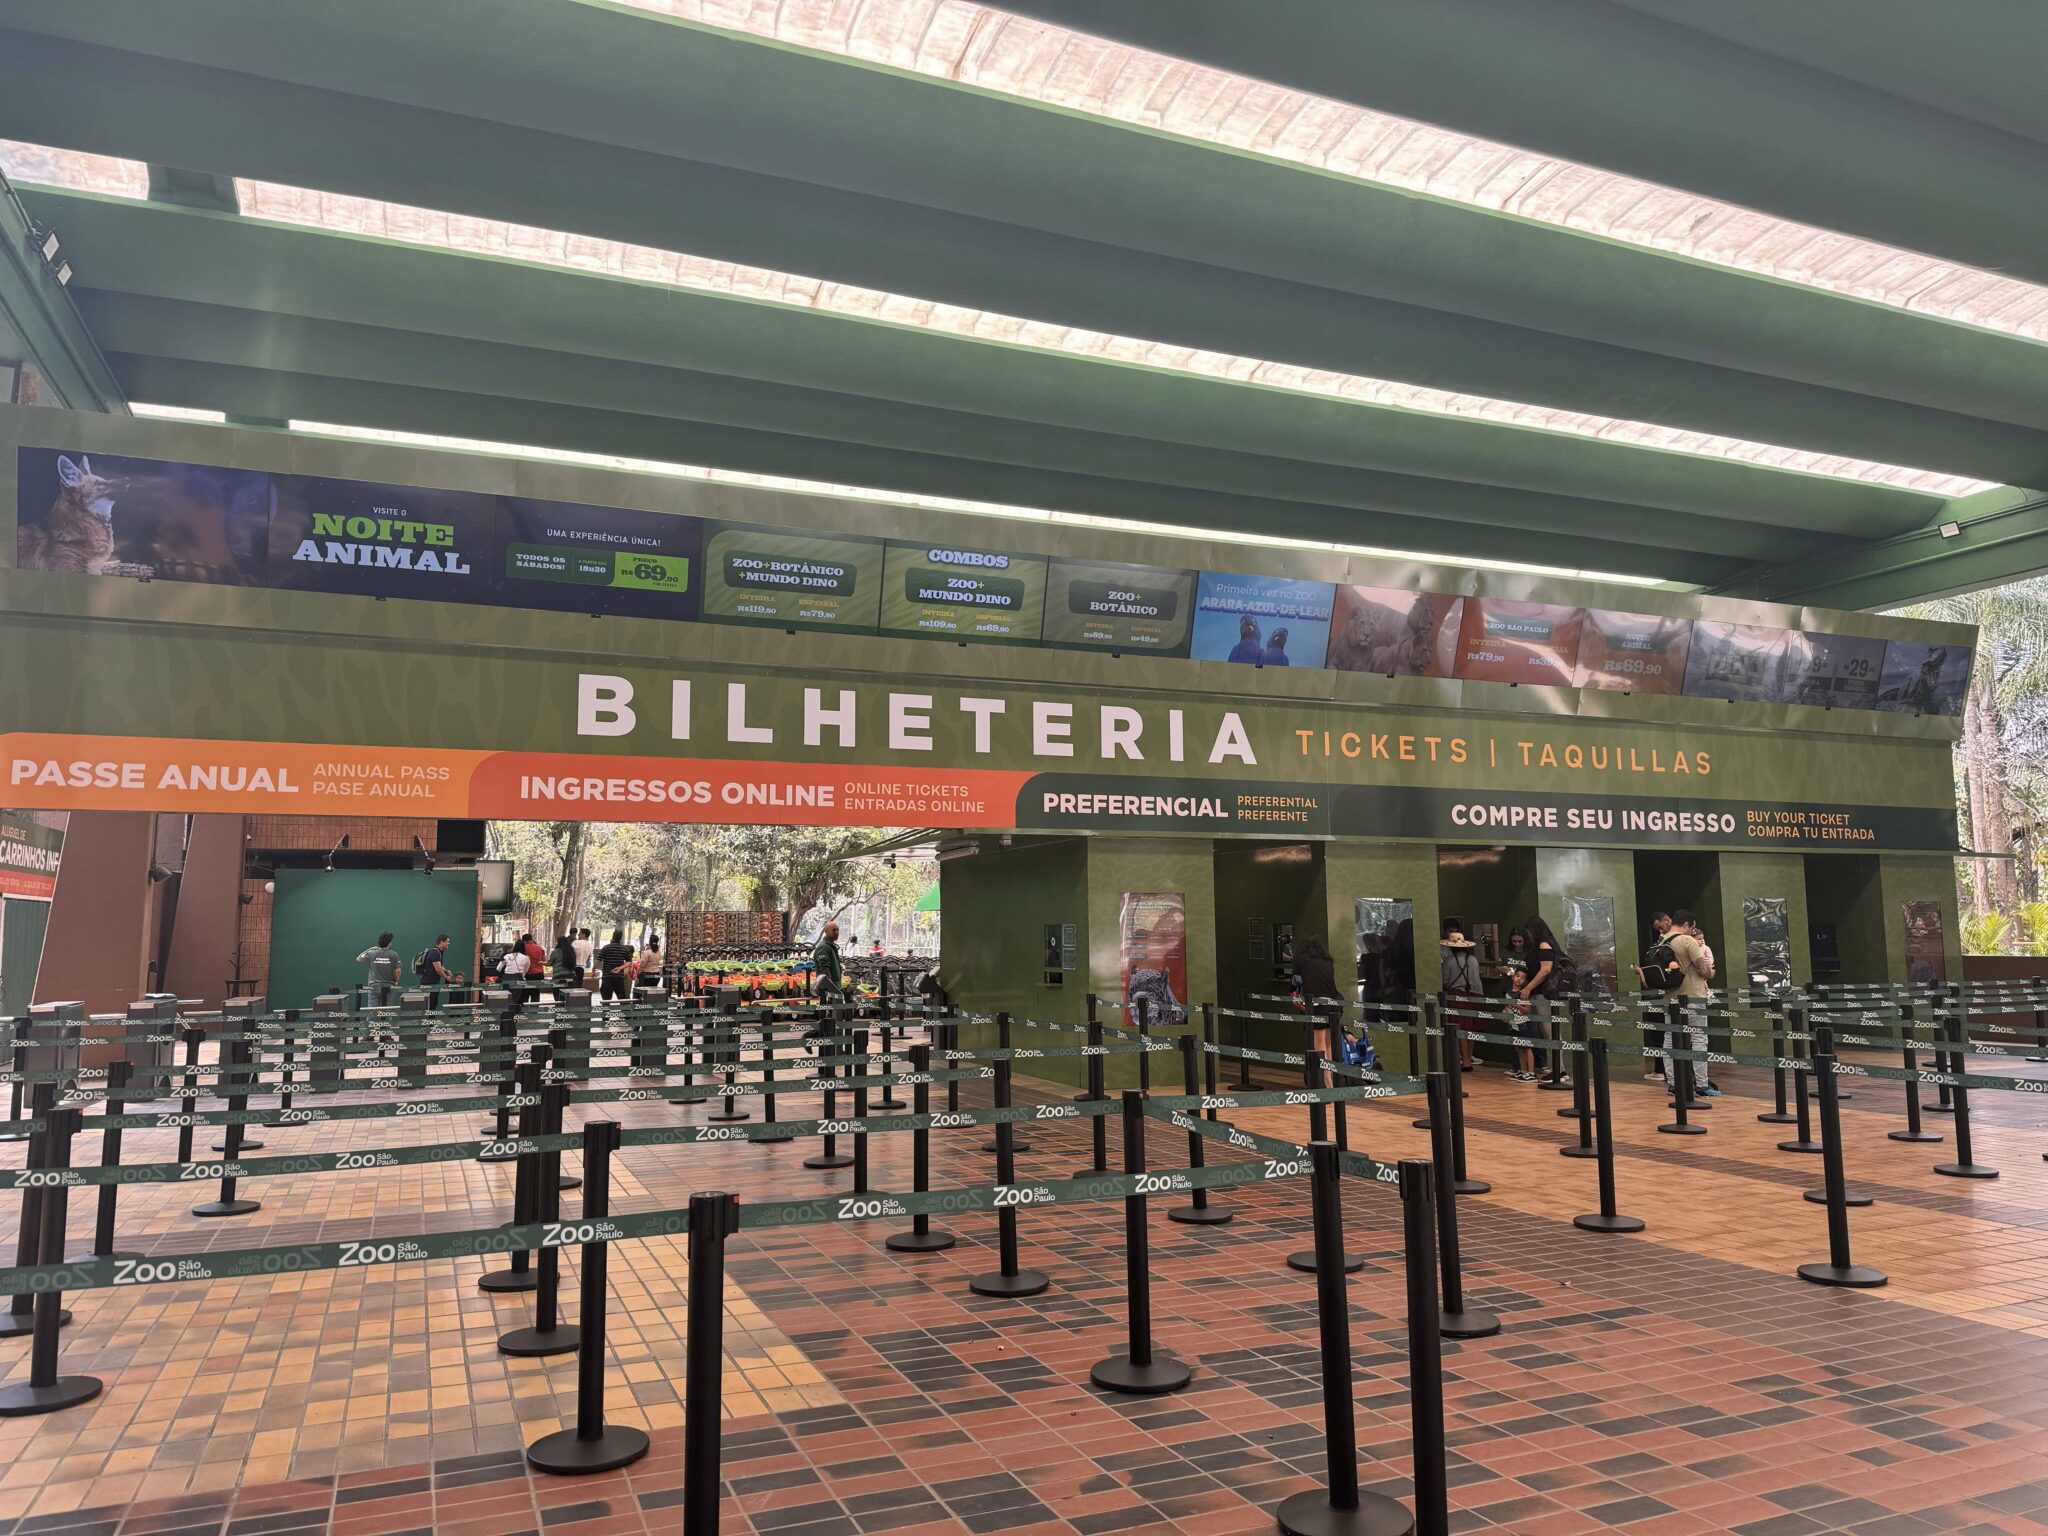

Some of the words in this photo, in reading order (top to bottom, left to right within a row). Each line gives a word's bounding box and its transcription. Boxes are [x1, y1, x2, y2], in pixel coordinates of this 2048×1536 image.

[373, 506, 398, 516] VISITE
[313, 513, 454, 546] NOITE
[547, 529, 567, 538] UMA
[570, 531, 629, 544] EXPERIÊNCIA
[631, 535, 661, 547] ÚNICA!
[293, 540, 470, 575] ANIMAL
[516, 554, 550, 562] TODOS
[928, 549, 1009, 568] COMBOS
[516, 560, 565, 571] SÁBADOS!
[802, 577, 838, 588] DINO
[919, 588, 974, 602] MUNDO
[975, 593, 1011, 605] DINO
[1217, 583, 1259, 597] Primeira
[1261, 589, 1278, 598] vez
[1280, 591, 1292, 599] no
[1090, 601, 1158, 616] BOTÂNICO
[1201, 597, 1329, 619] ARARA-AZUL-DE-LEAR
[1507, 623, 1522, 631] SÃO
[1523, 626, 1549, 634] PAULO
[1621, 641, 1652, 650] ANIMAL
[577, 673, 1258, 765] BILHETERIA
[1295, 730, 1467, 763] TICKETS
[1518, 742, 1711, 775] TAQUILLAS
[10, 760, 146, 789] PASSE
[157, 764, 299, 793] ANUAL
[313, 762, 394, 779] ANNUAL
[401, 765, 450, 780] PASS
[313, 781, 363, 796] PASE
[369, 783, 435, 798] ANUAL
[520, 775, 712, 805] INGRESSOS
[722, 782, 835, 808] ONLINE
[844, 782, 901, 796] ONLINE
[905, 783, 968, 798] TICKETS
[844, 798, 926, 813] ENTRADAS
[930, 799, 985, 814] ONLINE
[1043, 793, 1228, 818] PREFERENCIAL
[1237, 795, 1318, 809] PREFERENTIAL
[1238, 809, 1308, 822] PREFERENTE
[1451, 804, 1558, 828] COMPRE
[1567, 808, 1613, 830] SEU
[1622, 810, 1736, 833] INGRESSO
[1747, 810, 1770, 823] BUY
[1773, 811, 1805, 824] YOUR
[1809, 813, 1850, 826] TICKET
[1, 825, 19, 839] ALUGUEL
[20, 829, 27, 841] DE
[1748, 825, 1799, 838] COMPRA
[1803, 827, 1818, 839] TU
[1822, 828, 1875, 840] ENTRADA
[0, 840, 46, 870] CARRINHOS
[1733, 1029, 1748, 1037] Zoo
[1989, 1024, 2005, 1033] Zoo
[1906, 1039, 1924, 1049] Zoo
[1707, 1052, 1726, 1063] Zoo
[1778, 1058, 1799, 1069] Zoo
[78, 1068, 103, 1077] Zoo
[712, 1063, 735, 1073] Zoo
[1832, 1062, 1855, 1074] Zoo
[466, 1072, 491, 1083] Zoo
[898, 1073, 921, 1084] Zoo
[1918, 1071, 1943, 1083] Zoo
[170, 1087, 199, 1097] Zoo
[273, 1083, 299, 1093] Zoo
[719, 1084, 744, 1096] Zoo
[1364, 1086, 1385, 1098] Zoo
[2015, 1079, 2042, 1092] Zoo
[620, 1088, 646, 1101] Zoo
[1286, 1092, 1307, 1104] Zoo
[396, 1102, 427, 1115] Zoo
[1202, 1096, 1225, 1109] Zoo
[280, 1109, 312, 1121] Zoo
[1036, 1105, 1064, 1119] Zoo
[156, 1113, 191, 1127] Zoo
[930, 1113, 960, 1127] Zoo
[696, 1126, 729, 1141] Zoo
[818, 1119, 848, 1135] Zoo
[1228, 1128, 1246, 1146] Zoo
[480, 1141, 517, 1157] Zoo
[518, 1140, 533, 1148] São
[518, 1146, 538, 1154] Paulo
[335, 1152, 376, 1169] Zoo
[376, 1152, 392, 1160] São
[376, 1158, 398, 1166] Paulo
[180, 1162, 223, 1180] Zoo
[224, 1163, 241, 1171] São
[1265, 1161, 1298, 1178] Zoo
[14, 1169, 60, 1187] Zoo
[62, 1171, 79, 1179] São
[1135, 1174, 1172, 1193] Zoo
[1172, 1180, 1192, 1189] Paulo
[993, 1186, 1032, 1206] Zoo
[1034, 1187, 1048, 1195] São
[1034, 1193, 1055, 1202] Paulo
[838, 1199, 881, 1219] Zoo
[883, 1200, 899, 1208] São
[883, 1205, 906, 1215] Paulo
[595, 1222, 615, 1232] São
[542, 1223, 594, 1247] Zoo
[595, 1229, 624, 1240] Paulo
[397, 1242, 419, 1252] São
[339, 1242, 395, 1266] Zoo
[397, 1249, 428, 1260] Paulo
[178, 1260, 202, 1270] São
[113, 1260, 176, 1285] Zoo
[178, 1268, 212, 1279] Paulo
